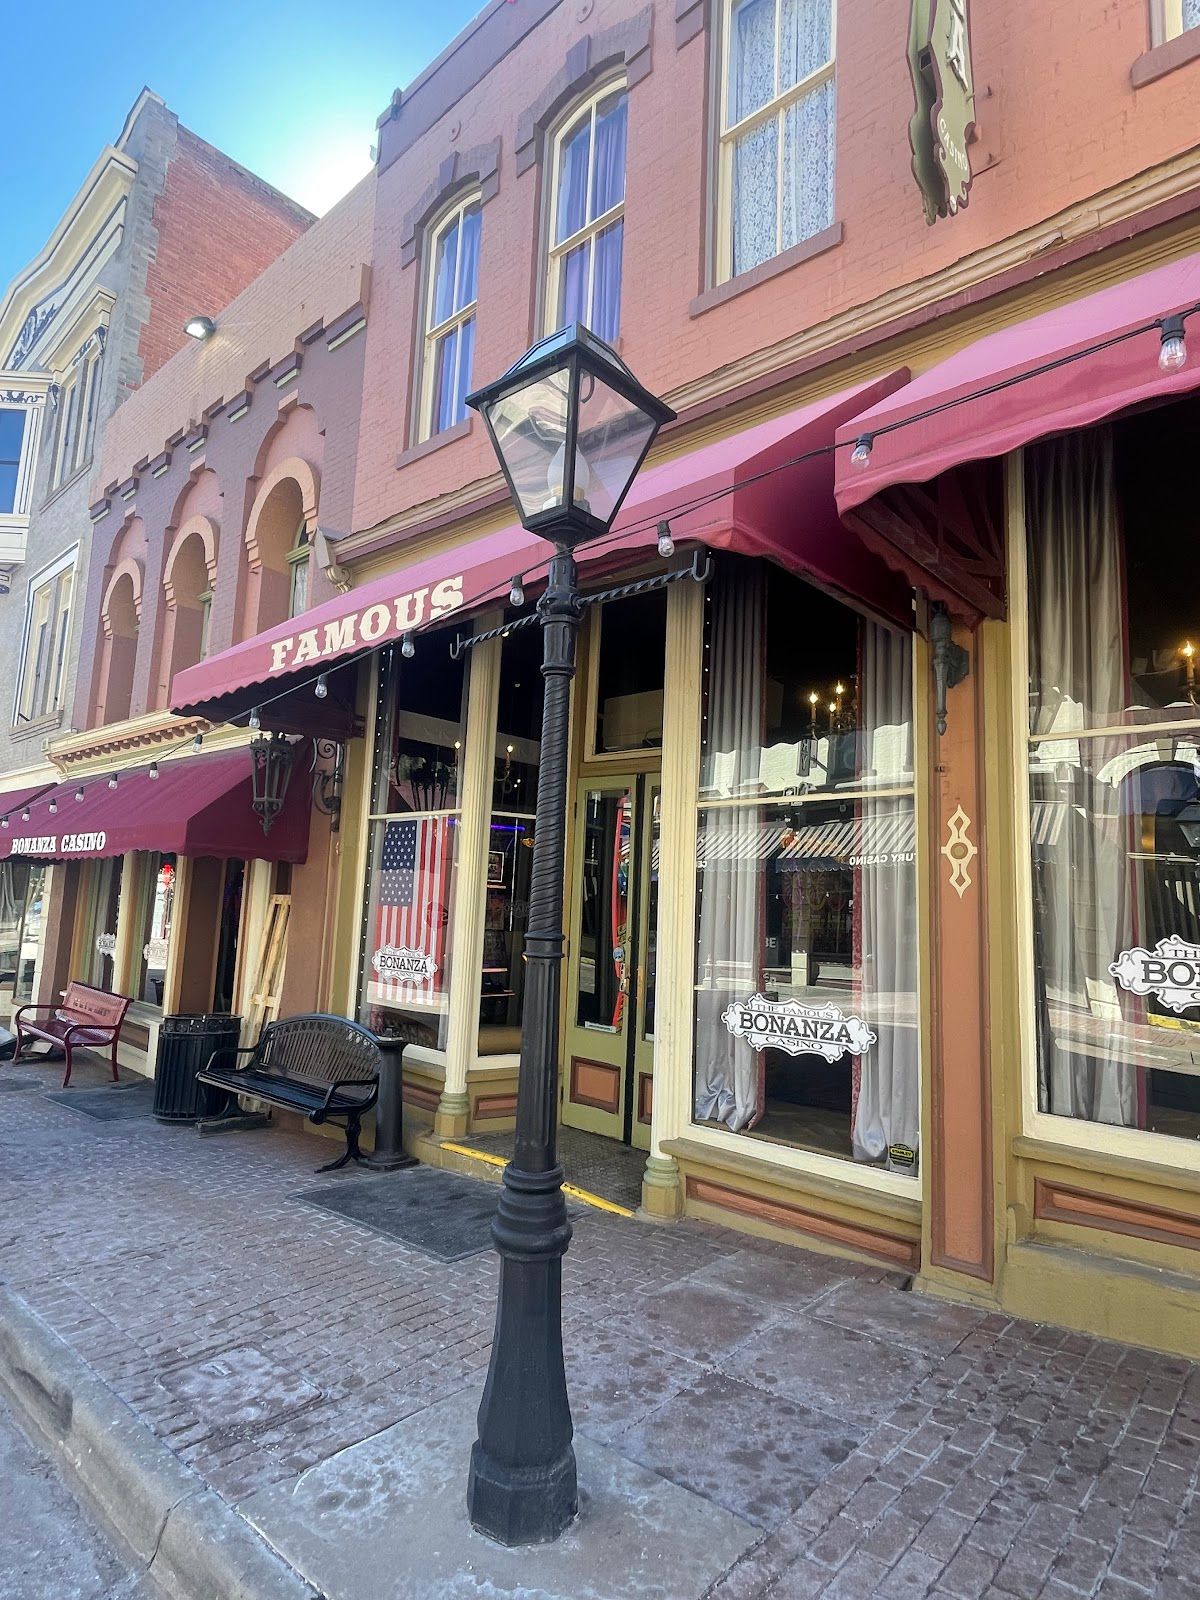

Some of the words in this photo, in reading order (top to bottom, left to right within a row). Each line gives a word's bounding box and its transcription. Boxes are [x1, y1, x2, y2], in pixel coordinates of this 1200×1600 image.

[269, 575, 464, 672] FAMOUS
[10, 836, 57, 854] BONANZA
[61, 831, 106, 852] CASINO
[379, 955, 428, 973] BONANZA
[755, 1003, 779, 1013] THE
[783, 1007, 834, 1019] FAMOUS
[739, 1011, 854, 1044] BONANZA
[765, 1036, 823, 1050] CASINO
